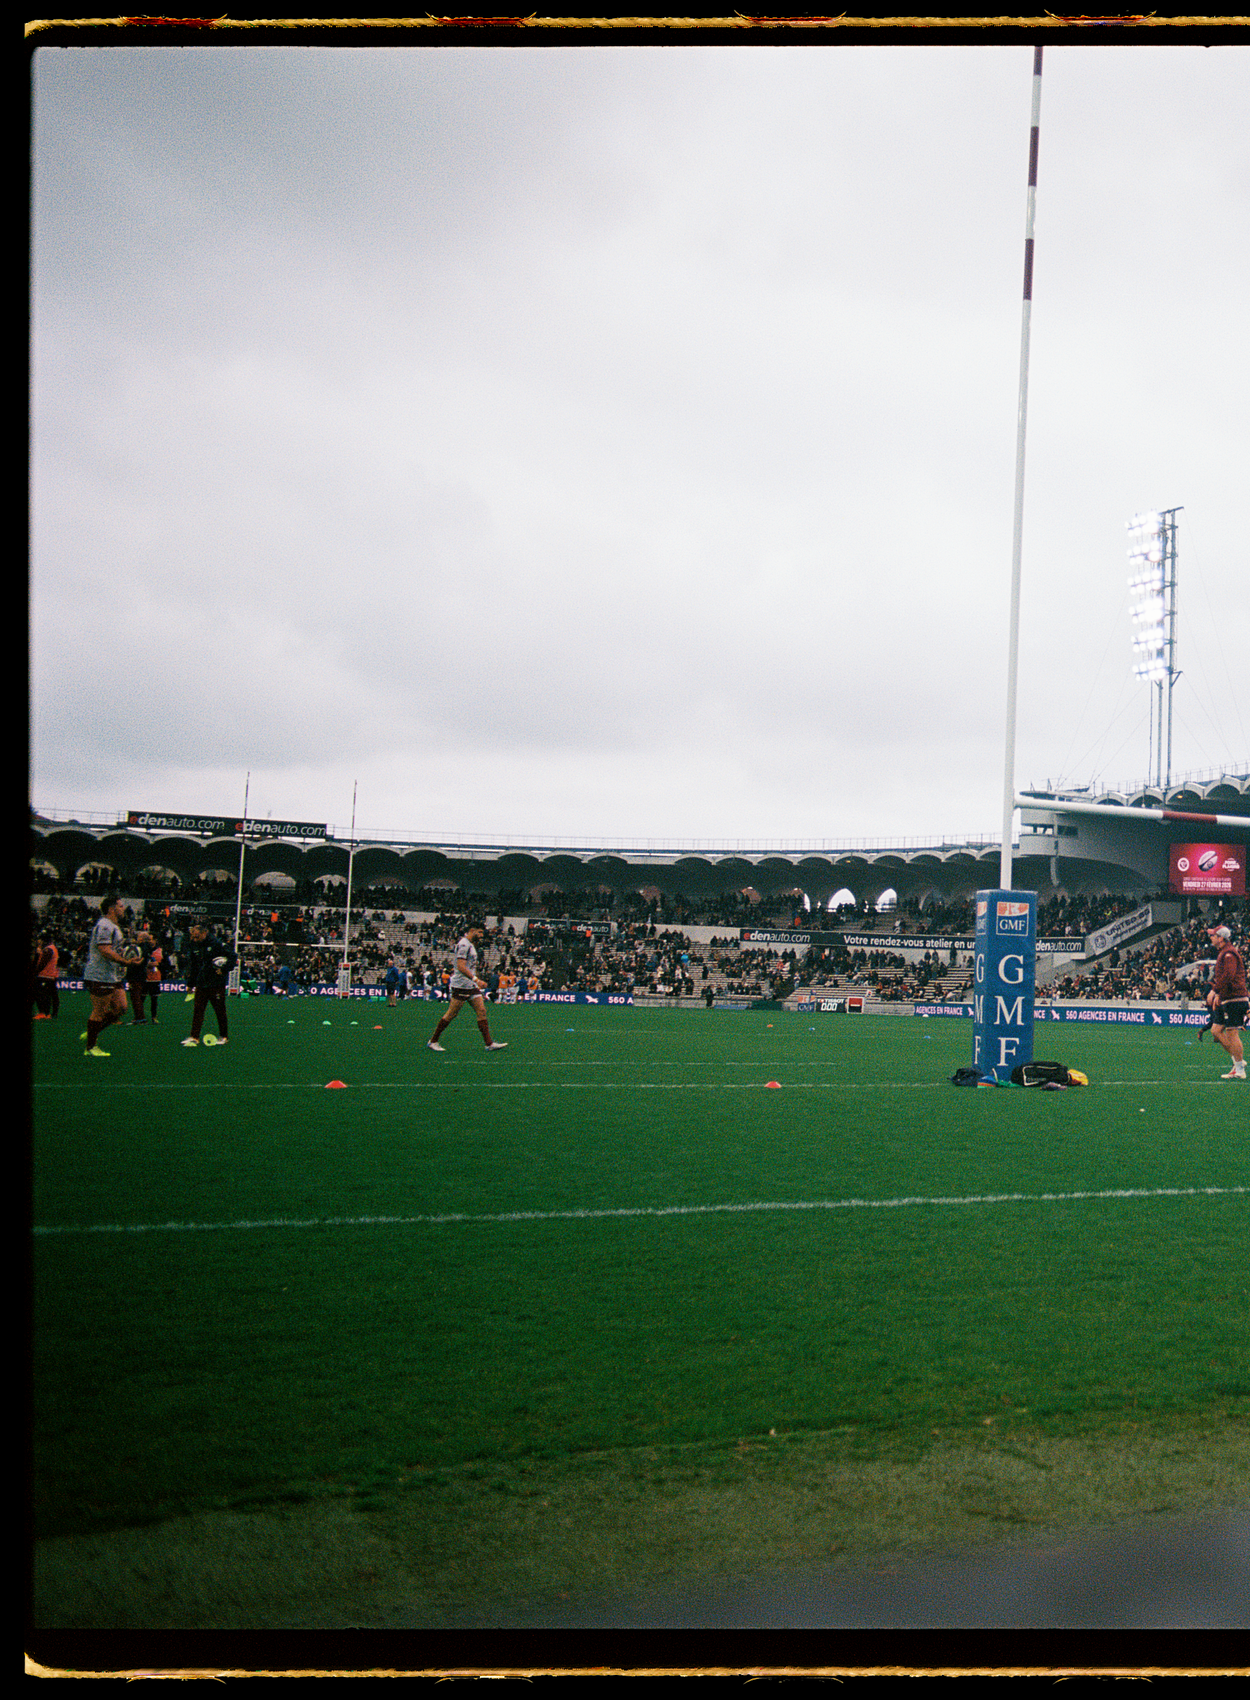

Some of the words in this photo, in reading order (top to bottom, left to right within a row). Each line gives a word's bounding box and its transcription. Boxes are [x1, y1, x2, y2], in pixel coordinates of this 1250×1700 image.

[129, 813, 225, 830] edenauto.com
[235, 820, 327, 836] edenauto.com
[169, 904, 207, 914] denauto
[999, 919, 1026, 931] GMF
[743, 930, 810, 943] edenauto.com
[843, 934, 868, 945] Votre
[870, 935, 924, 948] rendez-vous
[925, 937, 952, 949] atelier
[954, 939, 965, 949] en
[1035, 940, 1082, 951] denauto.com
[56, 981, 84, 990] ANCE
[369, 988, 382, 996] EN
[539, 993, 575, 1003] FRANCE
[608, 996, 625, 1004] 560
[915, 1006, 936, 1015] AGENCES
[937, 1006, 943, 1015] EN
[943, 1006, 963, 1016] FRANCE
[993, 954, 1025, 1067] GMF
[1065, 1010, 1078, 1020] 560
[1078, 1010, 1107, 1021] AGENCES
[1107, 1011, 1117, 1021] EN
[1118, 1011, 1145, 1023] FRANCE
[1169, 1013, 1183, 1024] 560
[1184, 1014, 1210, 1025] AGENC
